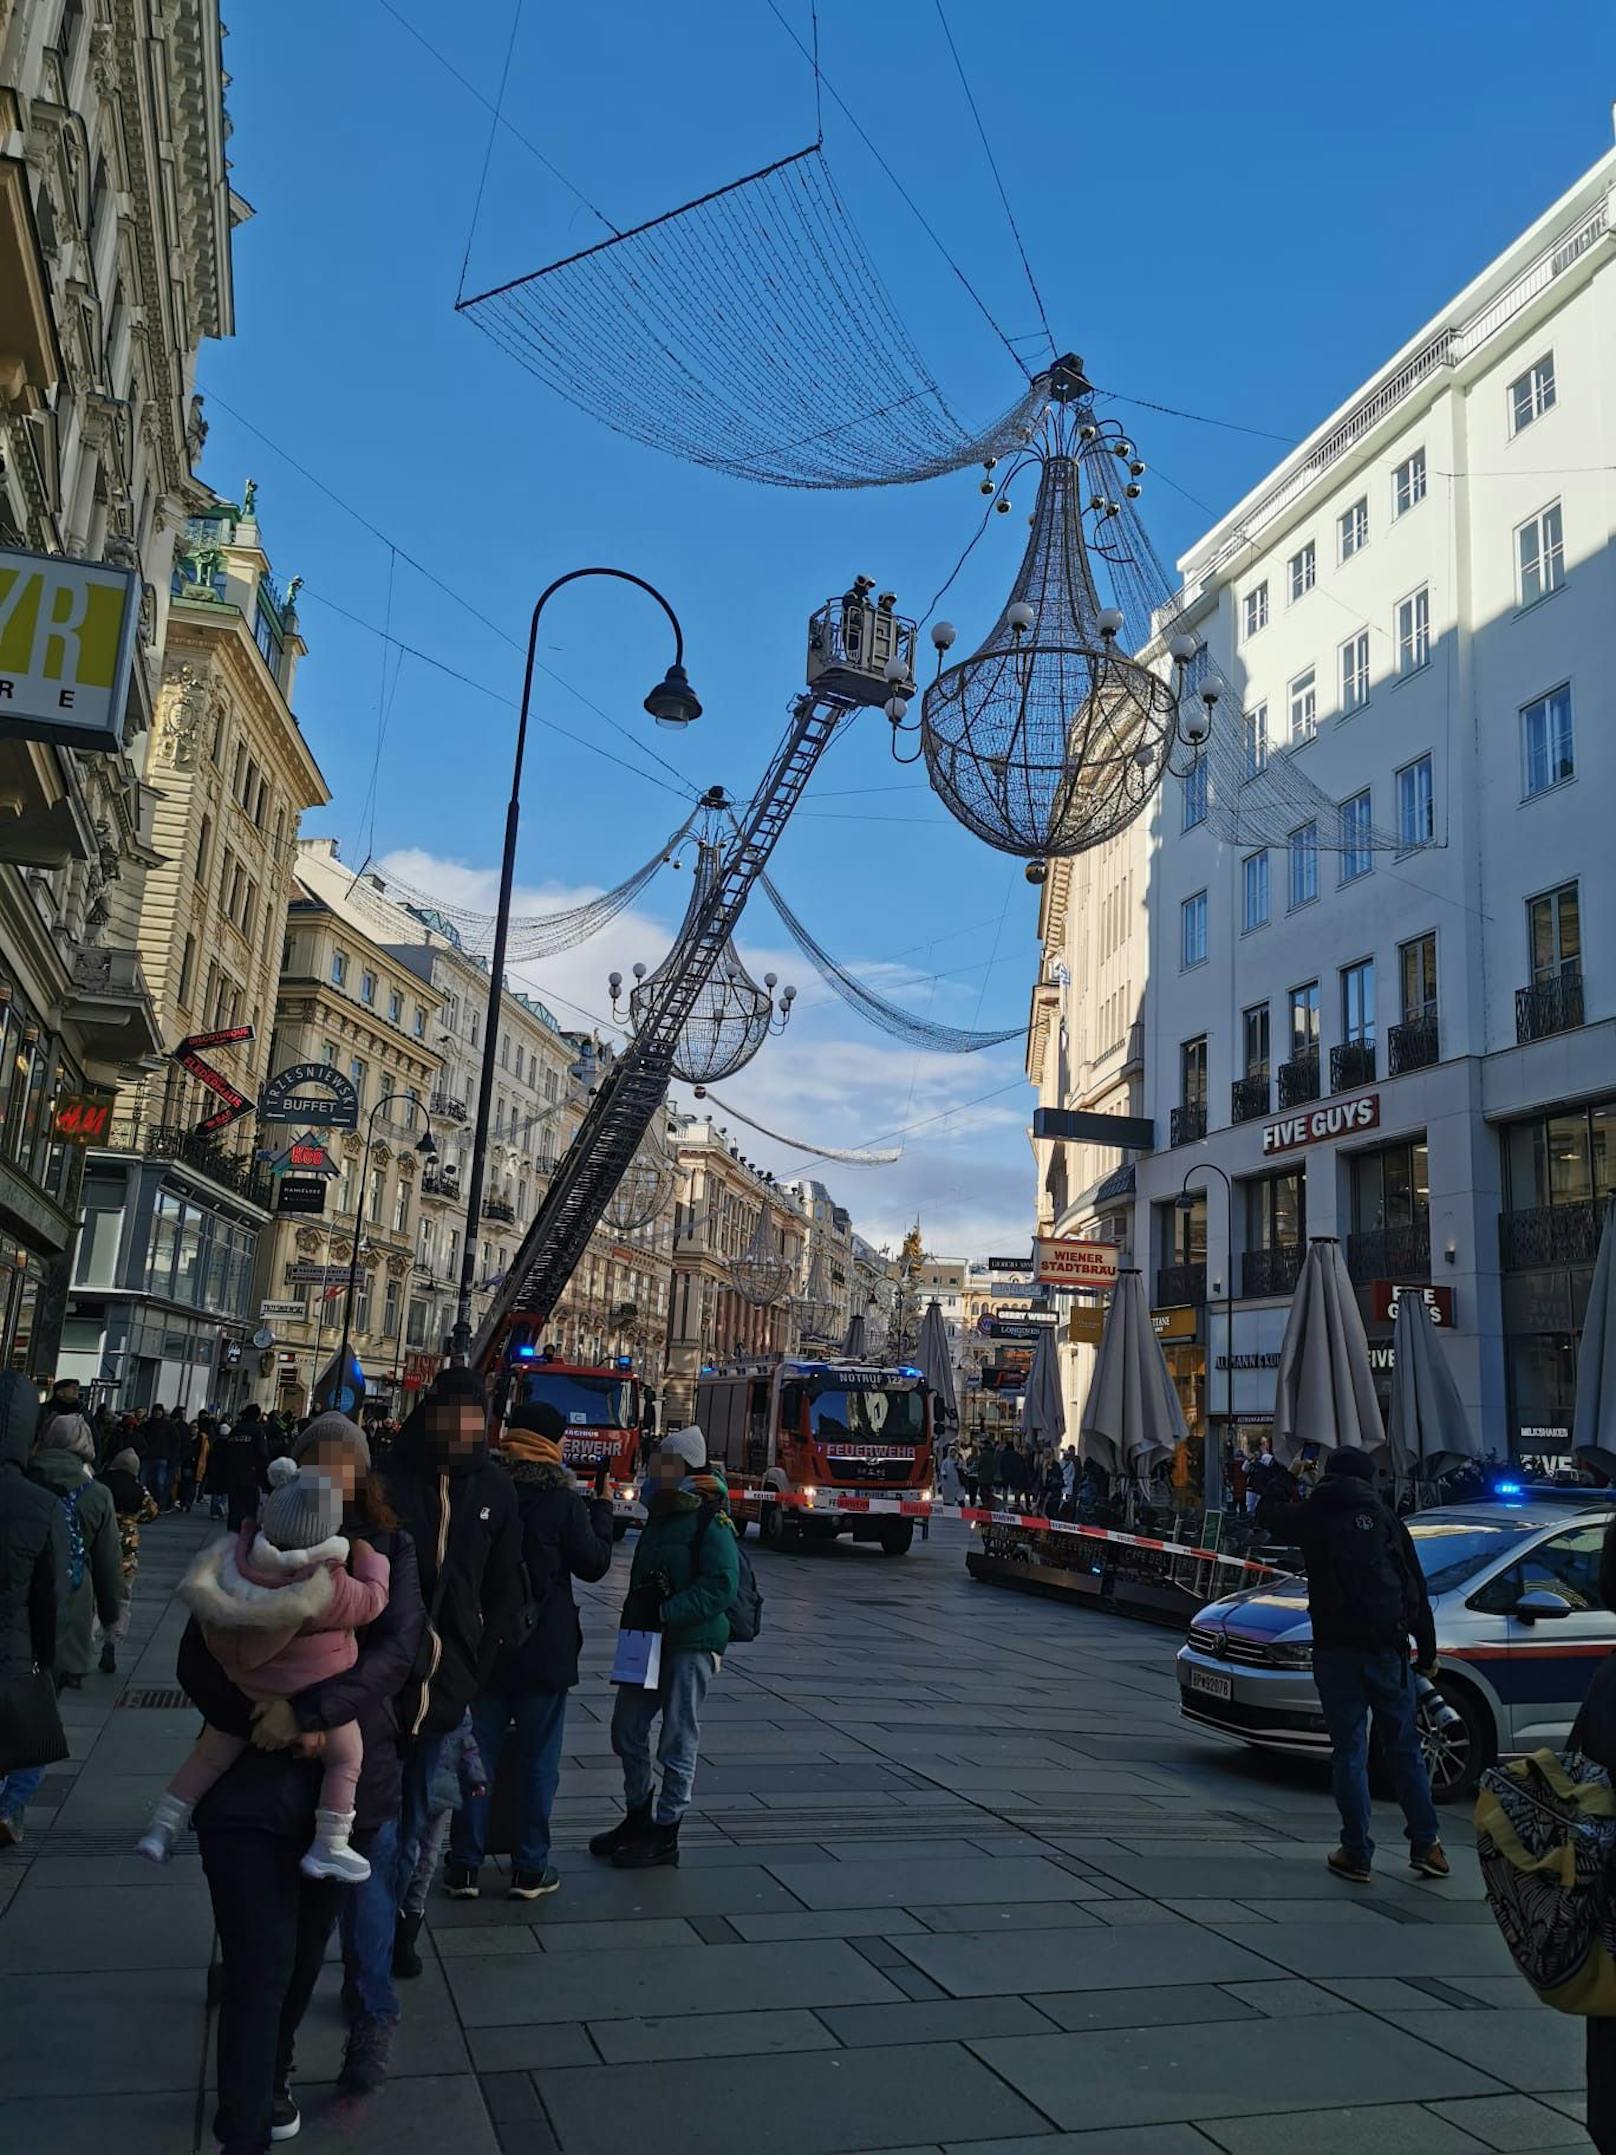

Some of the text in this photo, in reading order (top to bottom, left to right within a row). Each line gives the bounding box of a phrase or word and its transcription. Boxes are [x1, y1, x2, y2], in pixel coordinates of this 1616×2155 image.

[283, 1099, 337, 1113] BUFFET
[1263, 1099, 1374, 1150] FIVE GUYS
[1054, 1250, 1103, 1264] WIENER
[1392, 1286, 1436, 1304] FE
[1387, 1303, 1442, 1323] GS
[1368, 1349, 1395, 1368] IVE
[840, 1372, 903, 1385] NOTRUF 122
[827, 1444, 916, 1458] FEUERWEHR
